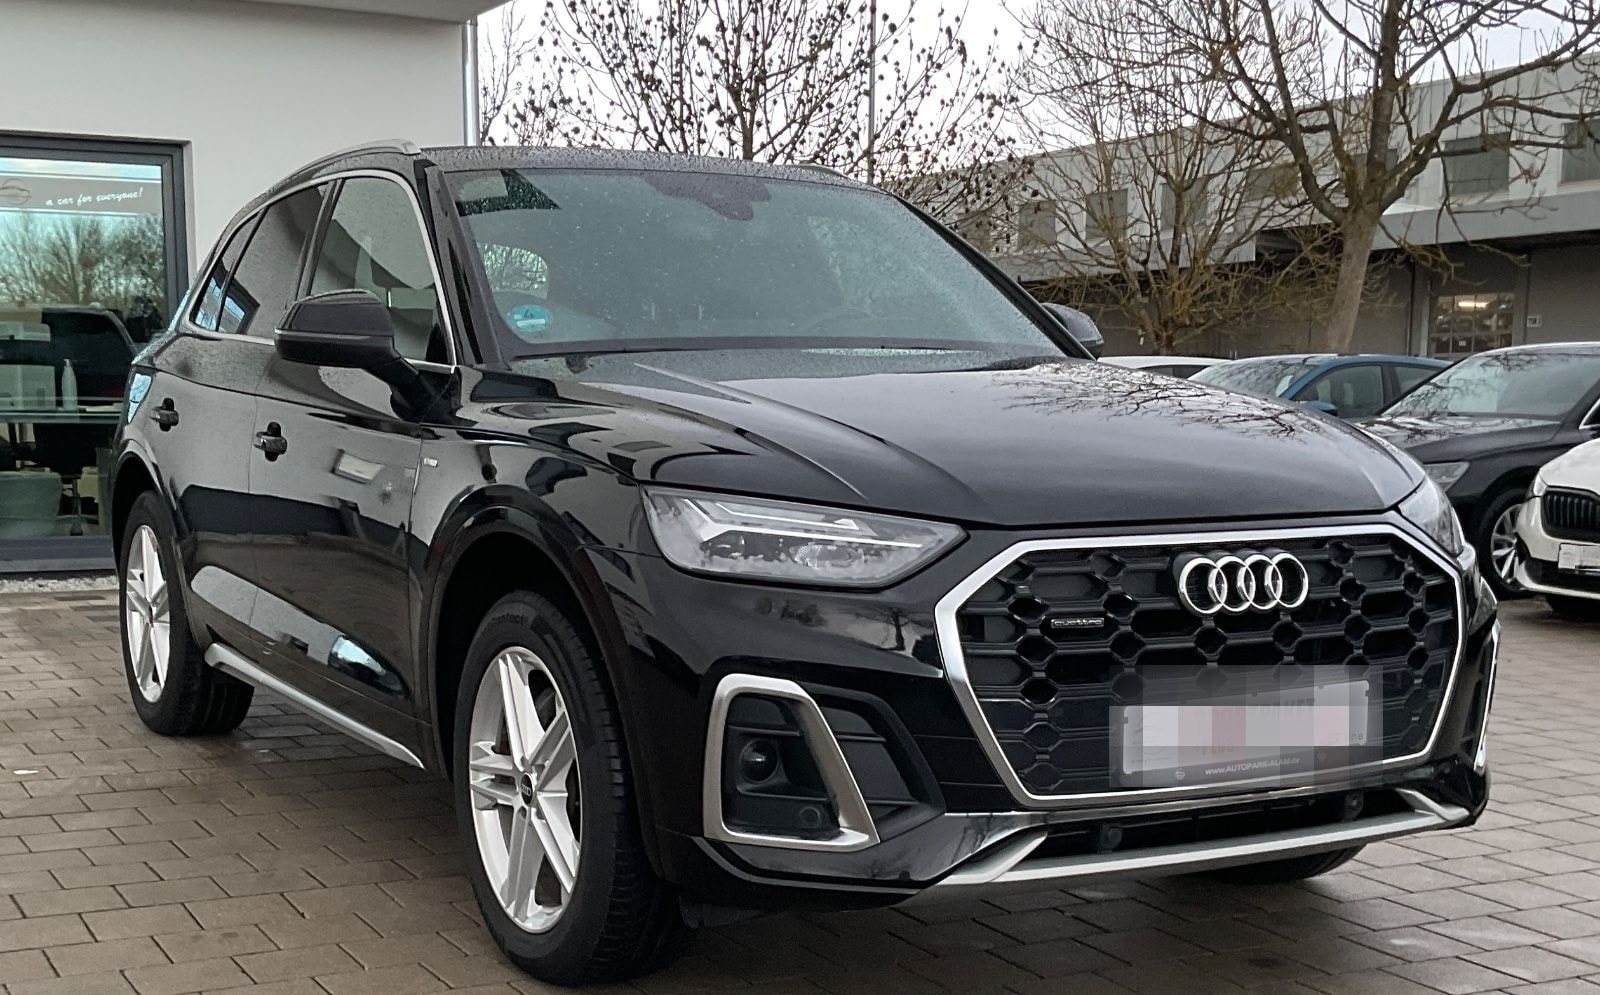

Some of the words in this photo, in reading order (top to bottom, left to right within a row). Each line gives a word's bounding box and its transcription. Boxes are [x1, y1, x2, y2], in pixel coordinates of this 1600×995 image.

[57, 197, 74, 206] car
[77, 194, 92, 206] for
[96, 187, 144, 202] everyone!
[1053, 619, 1103, 627] quattro
